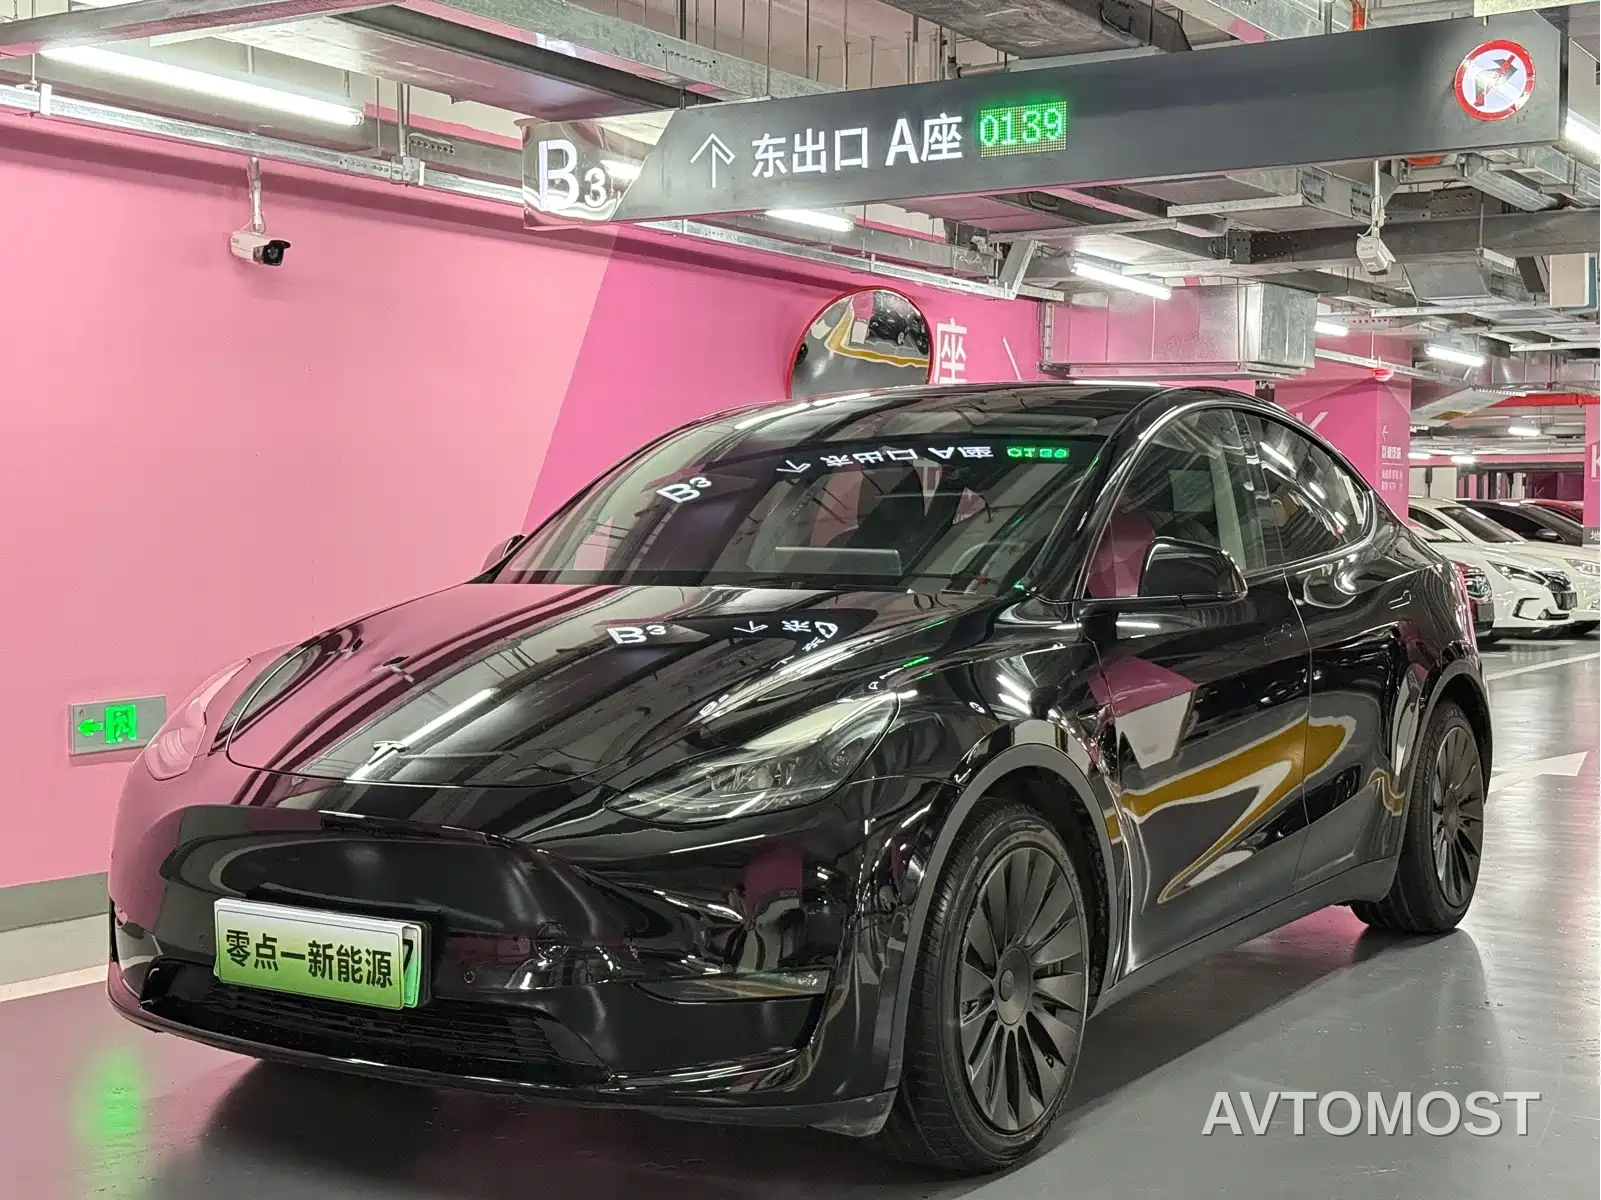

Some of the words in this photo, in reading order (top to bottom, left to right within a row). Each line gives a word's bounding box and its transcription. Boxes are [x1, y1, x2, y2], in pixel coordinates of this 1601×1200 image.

[751, 127, 869, 179] 东出口
[885, 112, 963, 167] A座
[979, 107, 1064, 147] 0139
[933, 316, 968, 384] 座
[225, 929, 393, 989] 零点一新能源
